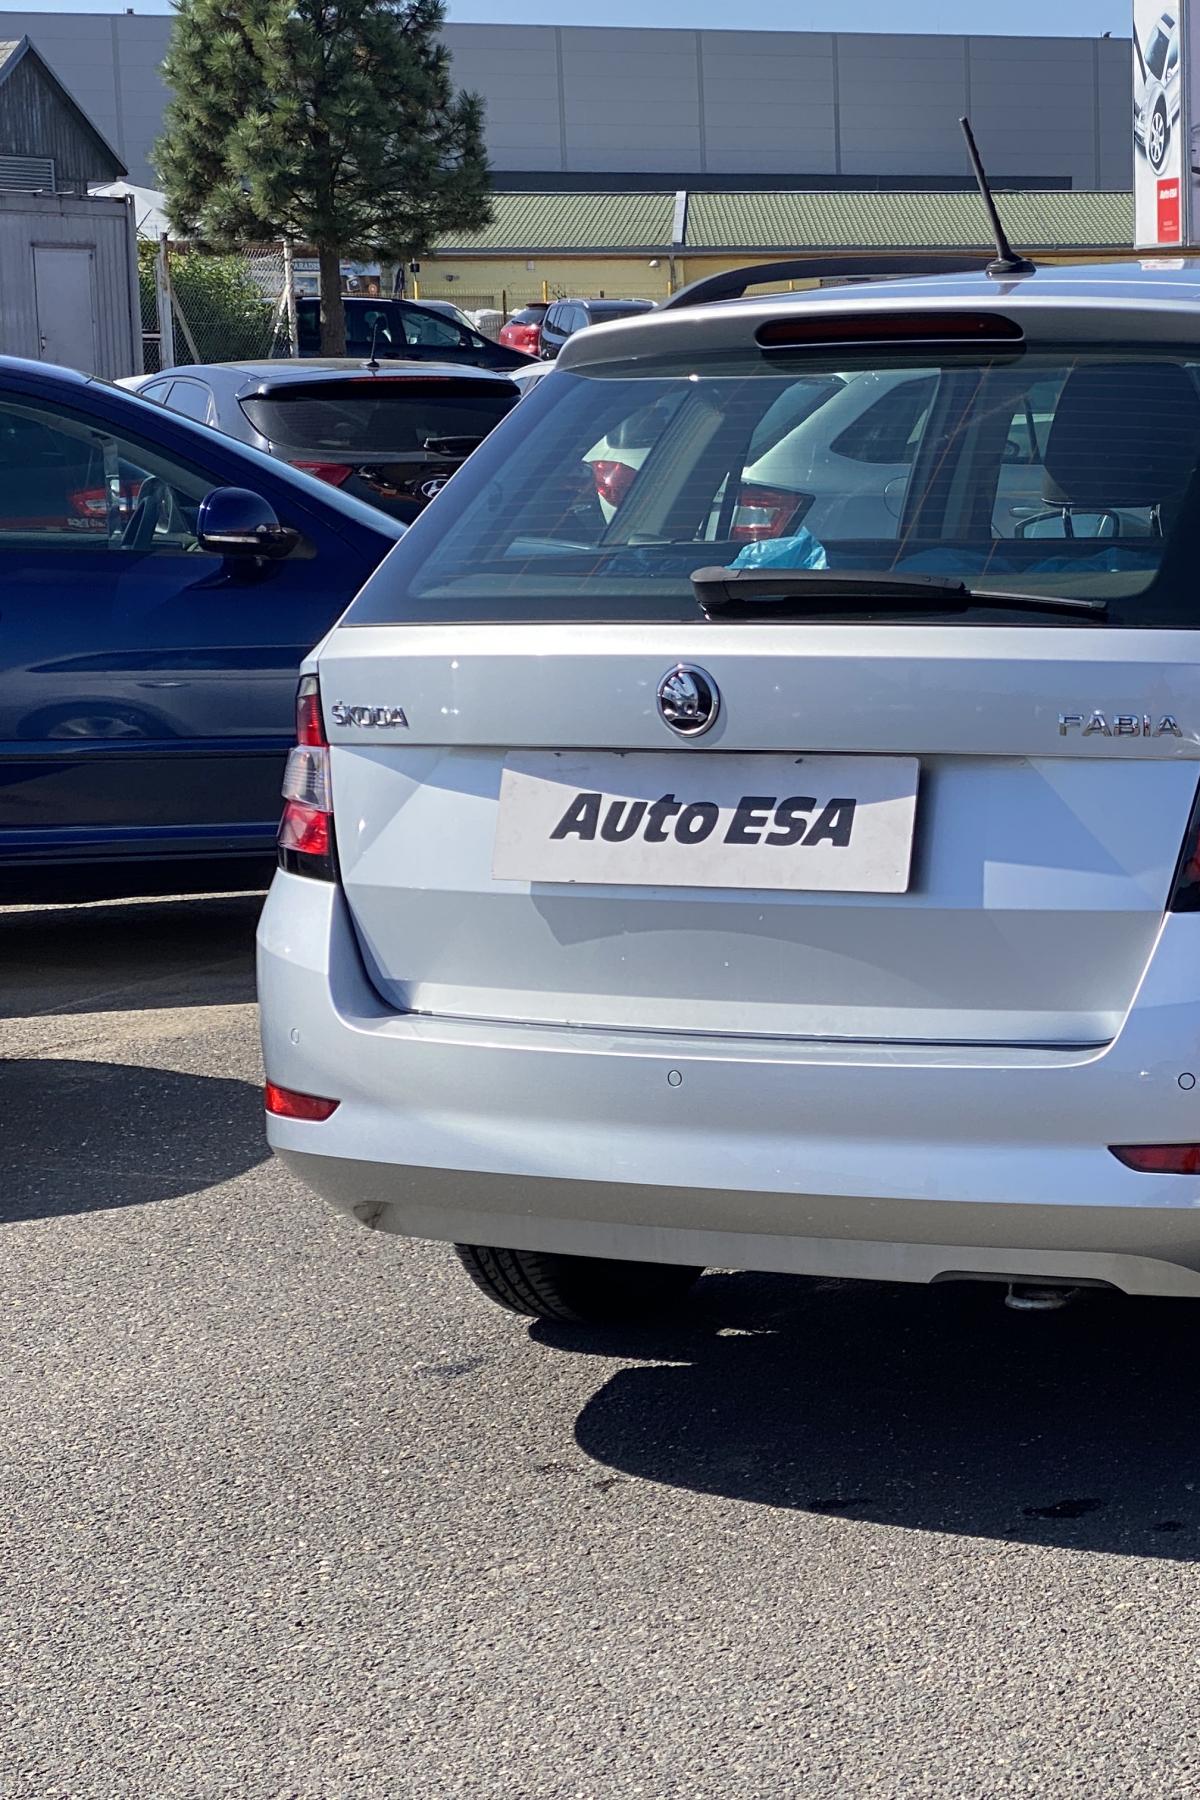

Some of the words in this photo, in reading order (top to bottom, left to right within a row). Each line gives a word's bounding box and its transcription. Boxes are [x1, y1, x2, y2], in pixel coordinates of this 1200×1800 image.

[331, 699, 410, 729] ŠKODA
[1058, 709, 1183, 737] FABIA
[549, 793, 720, 845] Auto
[723, 796, 857, 848] ESA
